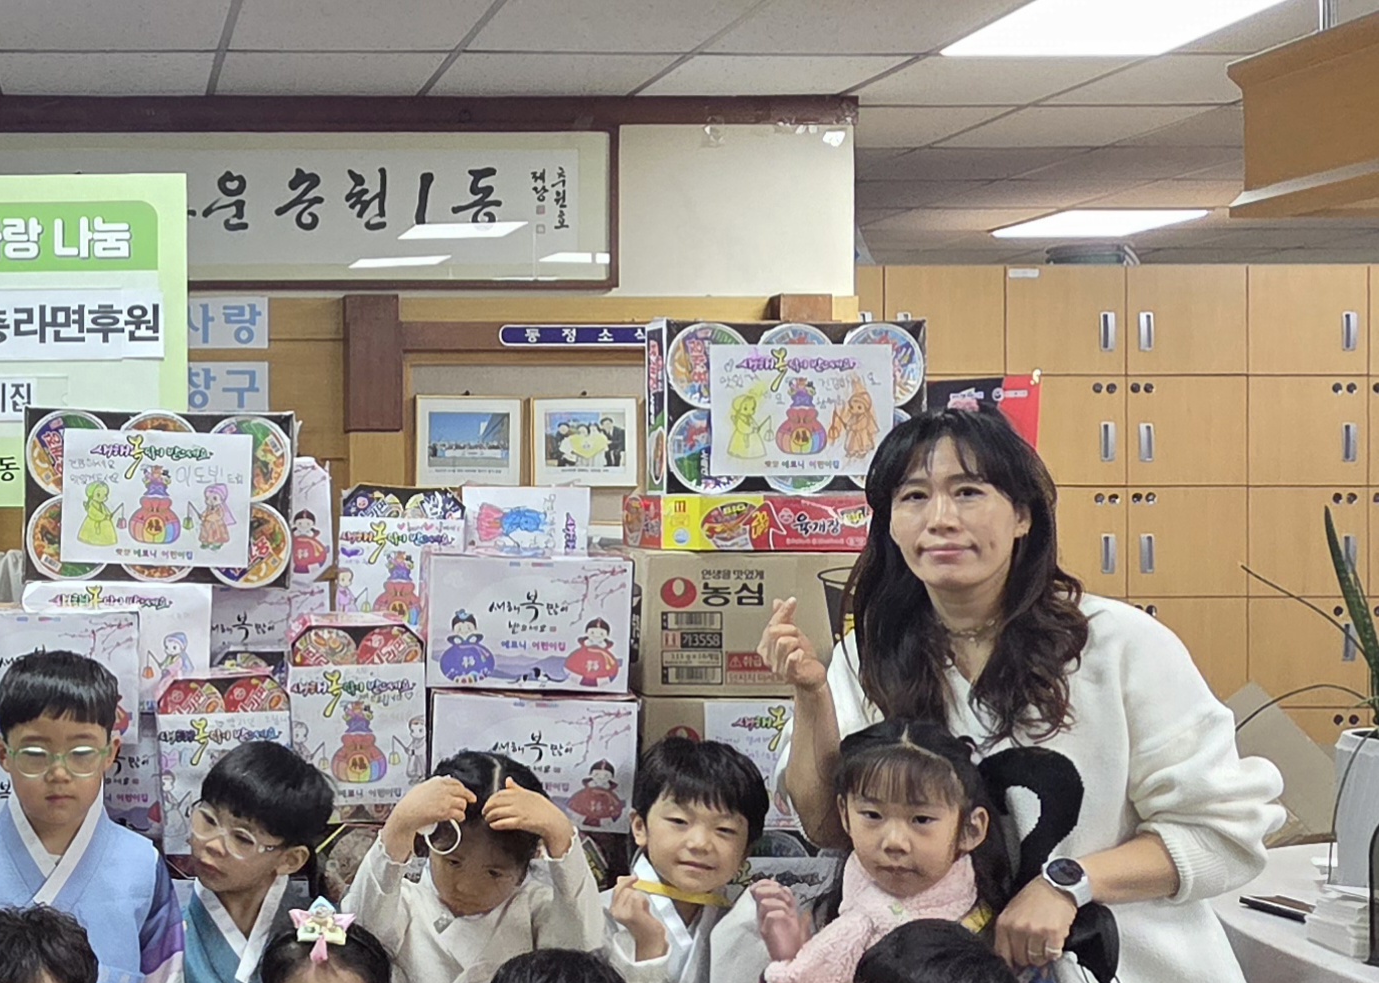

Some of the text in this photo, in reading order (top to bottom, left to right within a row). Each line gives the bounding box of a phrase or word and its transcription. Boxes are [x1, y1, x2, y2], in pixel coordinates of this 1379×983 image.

[188, 170, 249, 231] 운
[53, 216, 131, 260] 나눔
[793, 513, 841, 537] 육개장
[488, 588, 569, 624] 새해 복 많이
[700, 582, 764, 607] 농심
